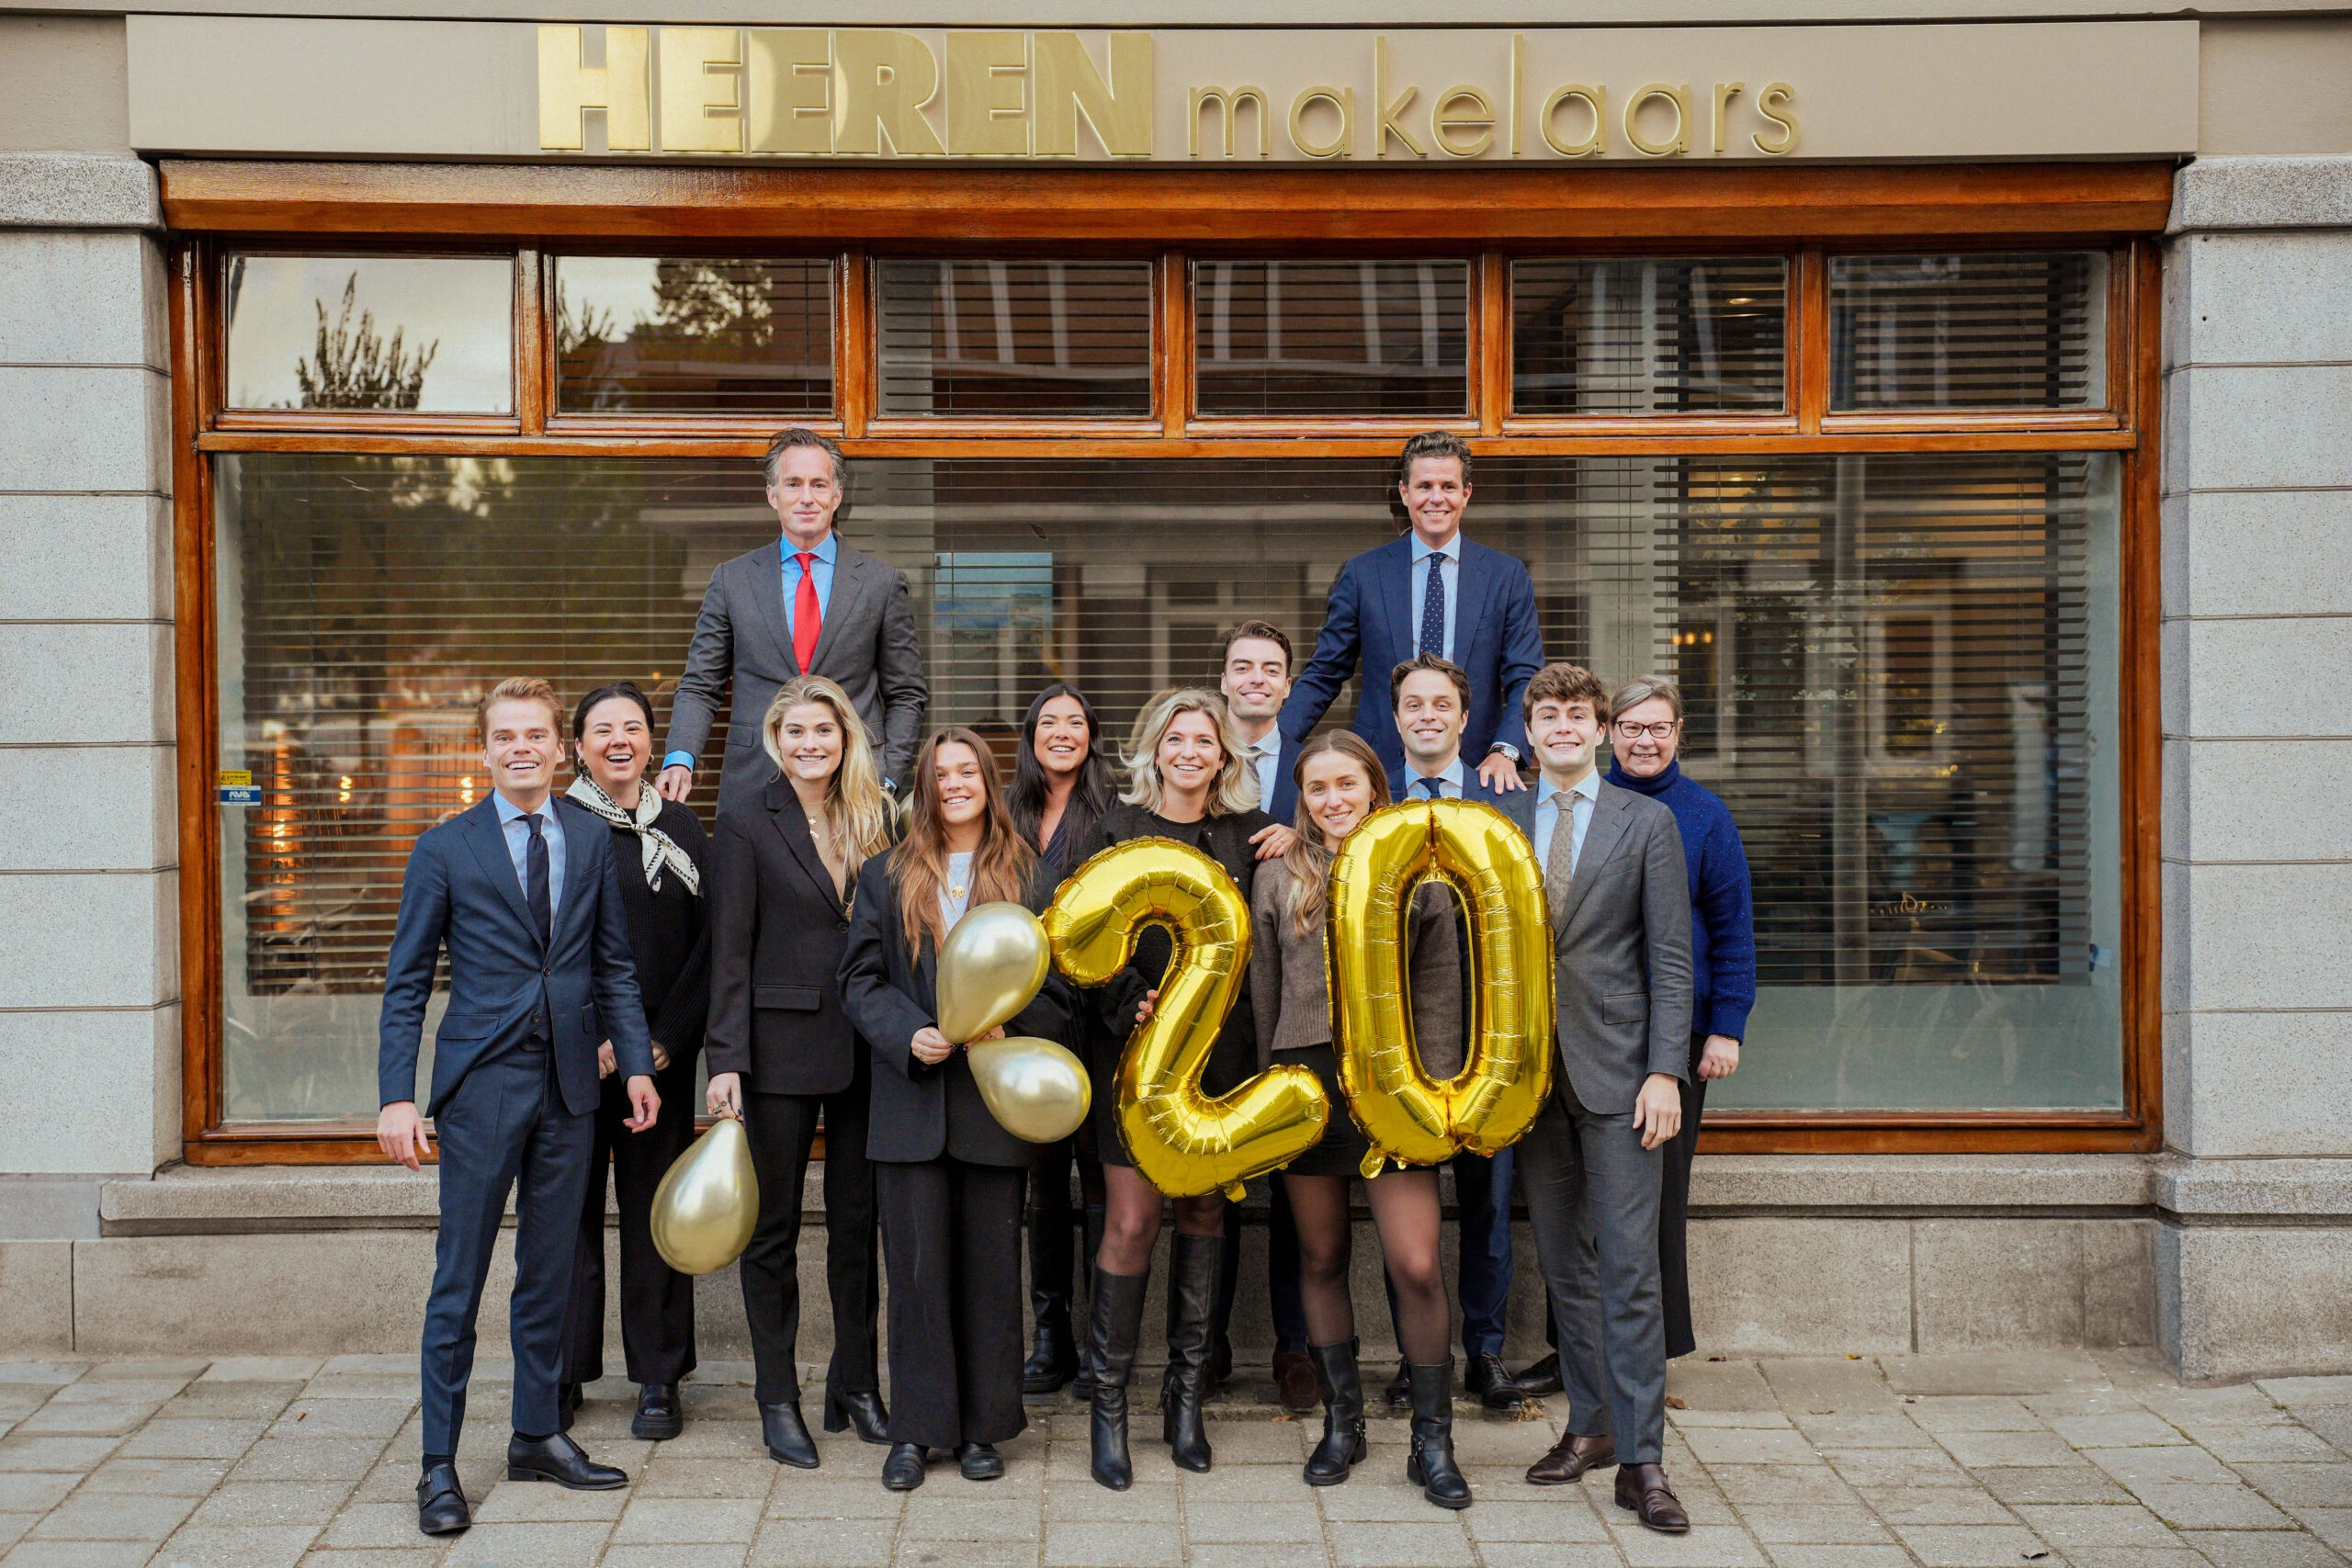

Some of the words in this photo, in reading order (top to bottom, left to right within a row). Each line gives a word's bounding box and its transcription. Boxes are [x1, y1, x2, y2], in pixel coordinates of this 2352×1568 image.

[537, 26, 1153, 157] HEEREN
[1189, 33, 1798, 157] makelaars
[1042, 796, 1557, 1201] 20
